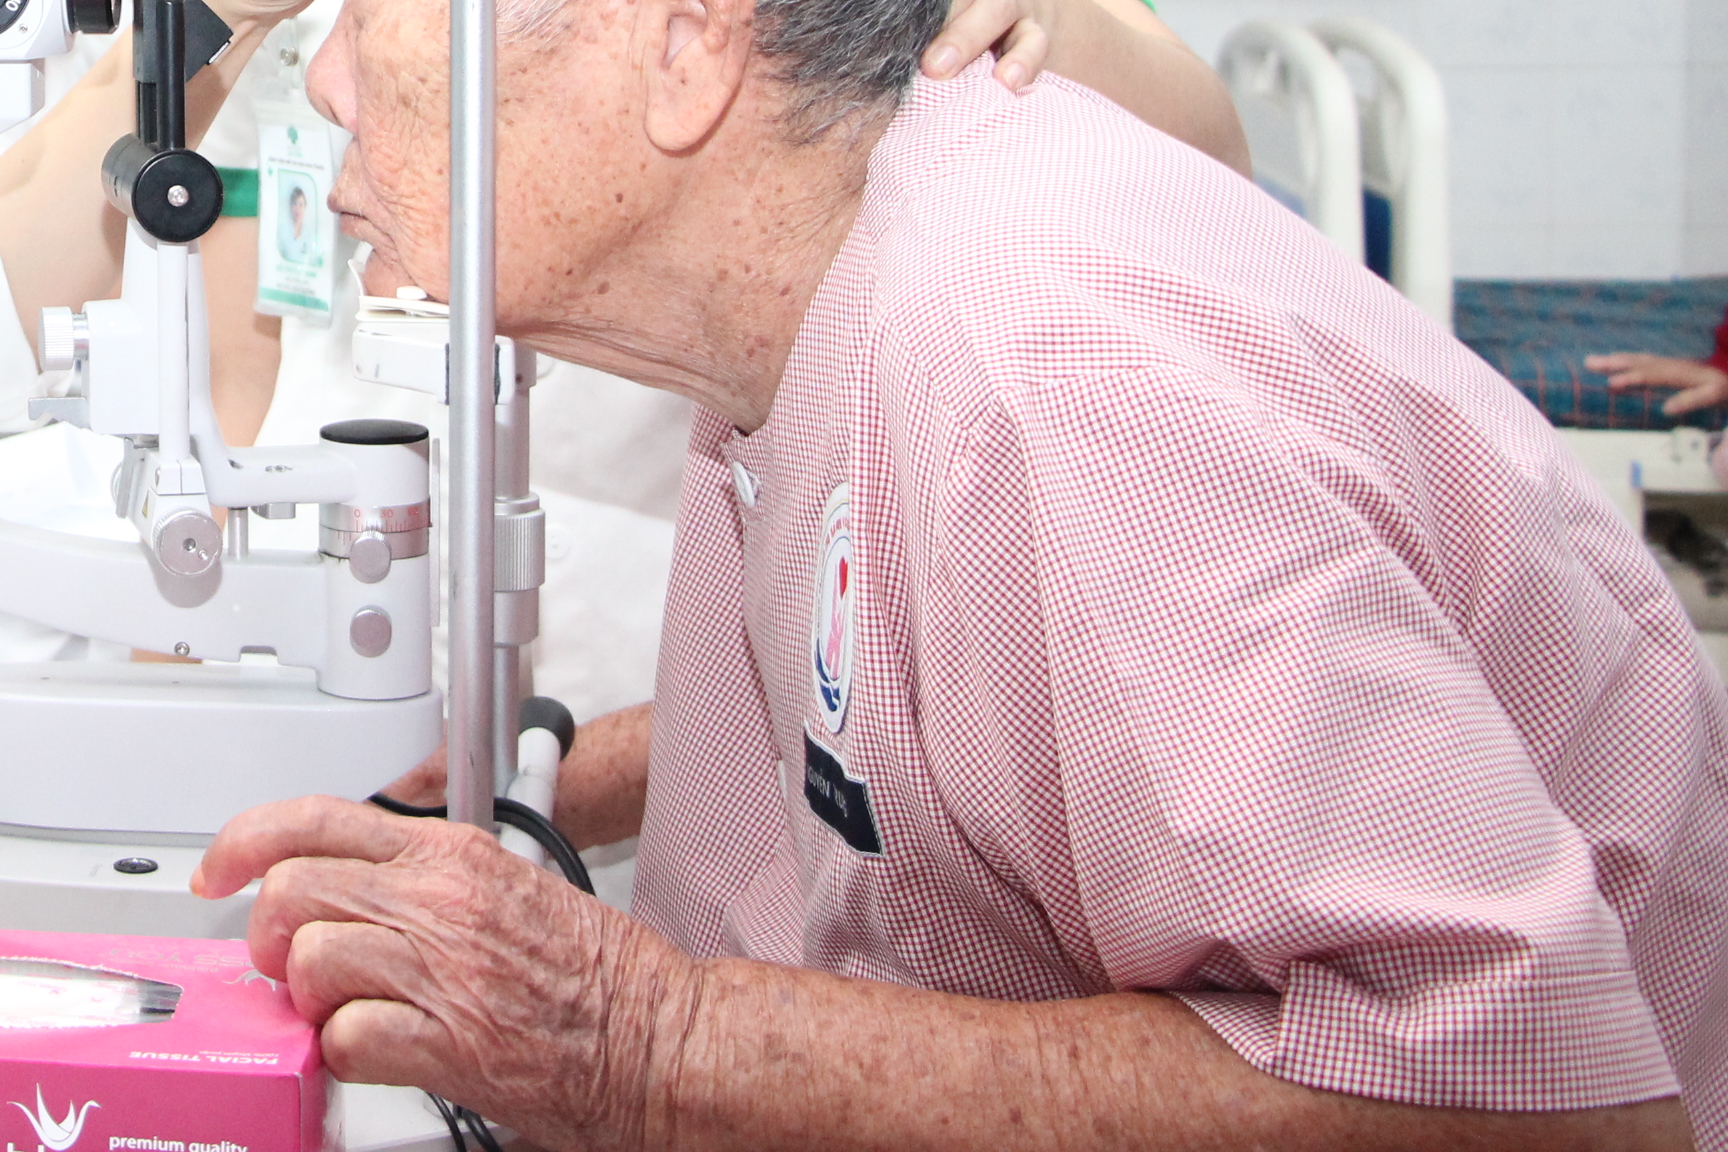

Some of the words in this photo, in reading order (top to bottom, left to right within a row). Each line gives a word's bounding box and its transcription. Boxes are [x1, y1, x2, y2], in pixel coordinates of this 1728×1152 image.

[129, 1051, 201, 1062] TISSUE
[205, 1055, 279, 1065] FACIAL
[109, 1136, 185, 1152] premium
